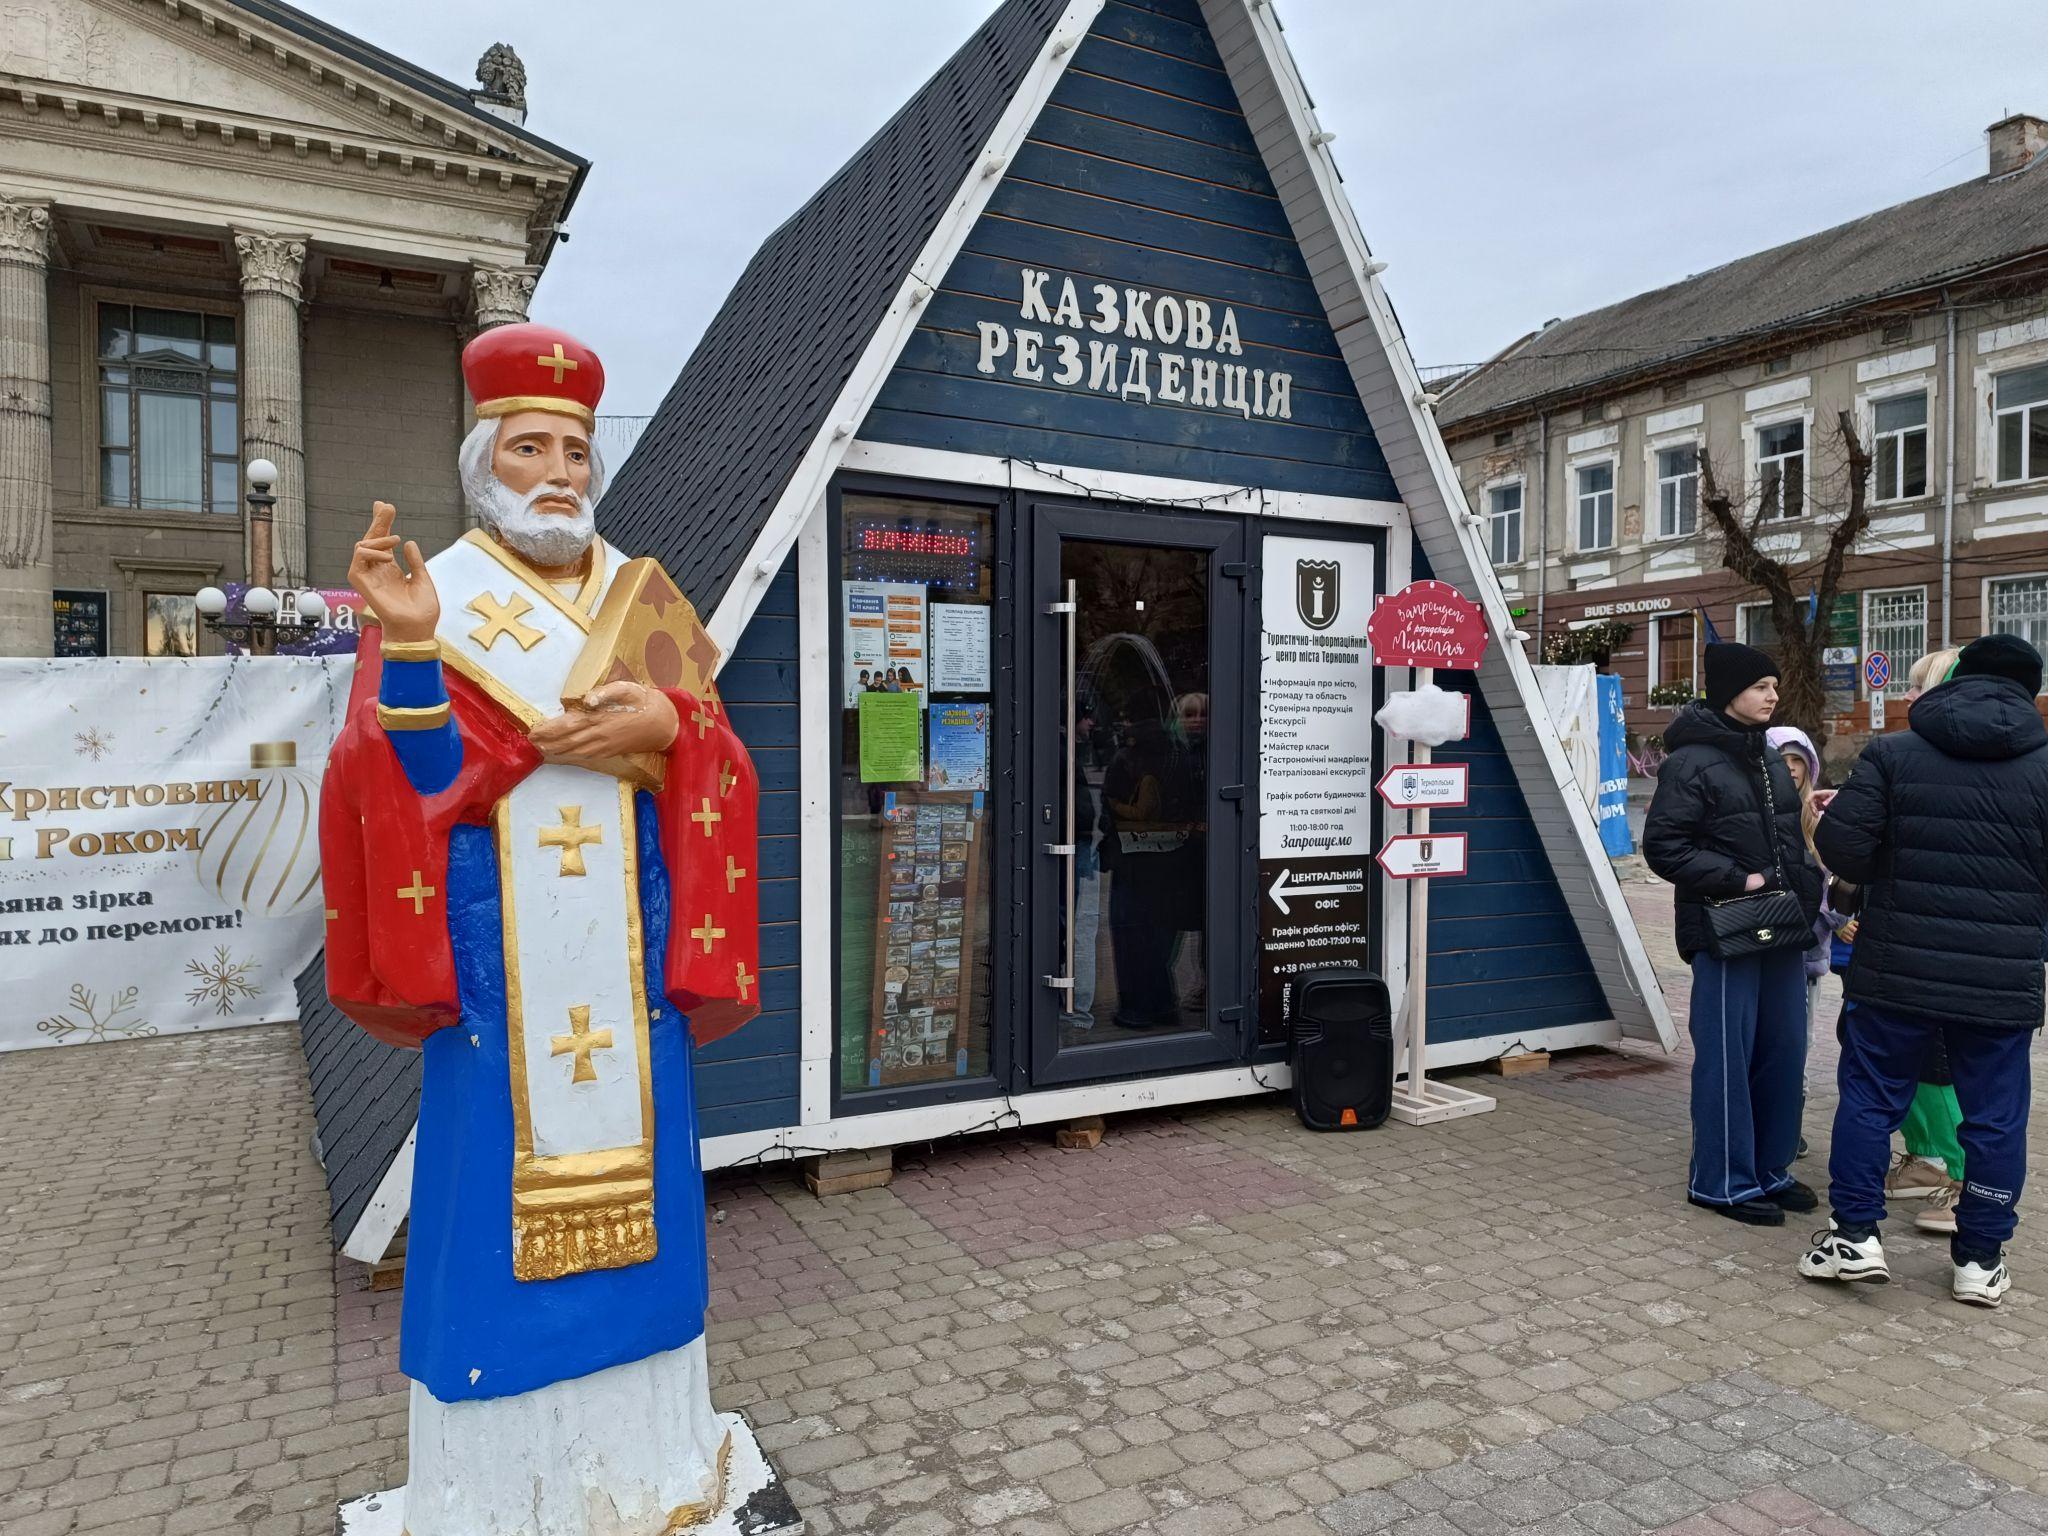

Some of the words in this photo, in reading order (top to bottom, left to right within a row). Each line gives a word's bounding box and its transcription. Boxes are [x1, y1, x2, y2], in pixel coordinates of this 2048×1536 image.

[1020, 268, 1243, 356] КАЗКОВА
[976, 320, 1292, 420] РЕЗИДЕНЦІЯ
[864, 529, 969, 556] ВІДЧИНЕНО
[1584, 603, 1614, 617] BUDE
[1616, 597, 1671, 614] SOLODKO
[1392, 629, 1466, 656] Миколая
[1275, 651, 1297, 663] центр
[1299, 650, 1320, 662] міста
[1321, 651, 1359, 664] Тернополя
[1269, 678, 1316, 688] Інформація
[1317, 680, 1333, 688] про
[1334, 678, 1357, 689] місто,
[1269, 692, 1303, 700] громаду
[1315, 691, 1347, 700] область
[1268, 703, 1311, 713] Сувенірна
[1312, 704, 1353, 714] продукція
[1268, 717, 1307, 726] Екскурсії
[1268, 730, 1298, 738] Квести
[1268, 742, 1304, 752] Майстер
[1305, 743, 1330, 751] класи
[1268, 755, 1327, 765] Гастрономічні
[1327, 755, 1370, 765] мандрівки
[1268, 768, 1328, 778] Театралізовані
[1329, 767, 1366, 777] екскурсії
[1266, 791, 1293, 802] Графік
[1294, 791, 1322, 801] роботи
[1323, 790, 1367, 801] будиночка:
[1310, 806, 1343, 815] святкові
[1343, 805, 1357, 815] дні
[1289, 823, 1329, 831] 11:00-18:00
[35, 828, 202, 860] Роком
[1280, 834, 1353, 852] Запрошуємо
[1291, 868, 1363, 884] ЦЕНТРАЛЬНИЙ
[1346, 884, 1362, 892] 100м
[0, 896, 64, 914] яна
[72, 890, 154, 912] зірка
[1315, 899, 1340, 910] ОФІС
[38, 926, 79, 946] до
[86, 909, 244, 942] перемоги!
[1272, 926, 1301, 938] Графік
[1303, 924, 1333, 936] роботи
[1334, 921, 1360, 932] офісу:
[1265, 941, 1306, 951] щоденно
[1306, 936, 1350, 947] 10:00-17:00
[1352, 936, 1366, 944] год
[1281, 963, 1297, 974] +38
